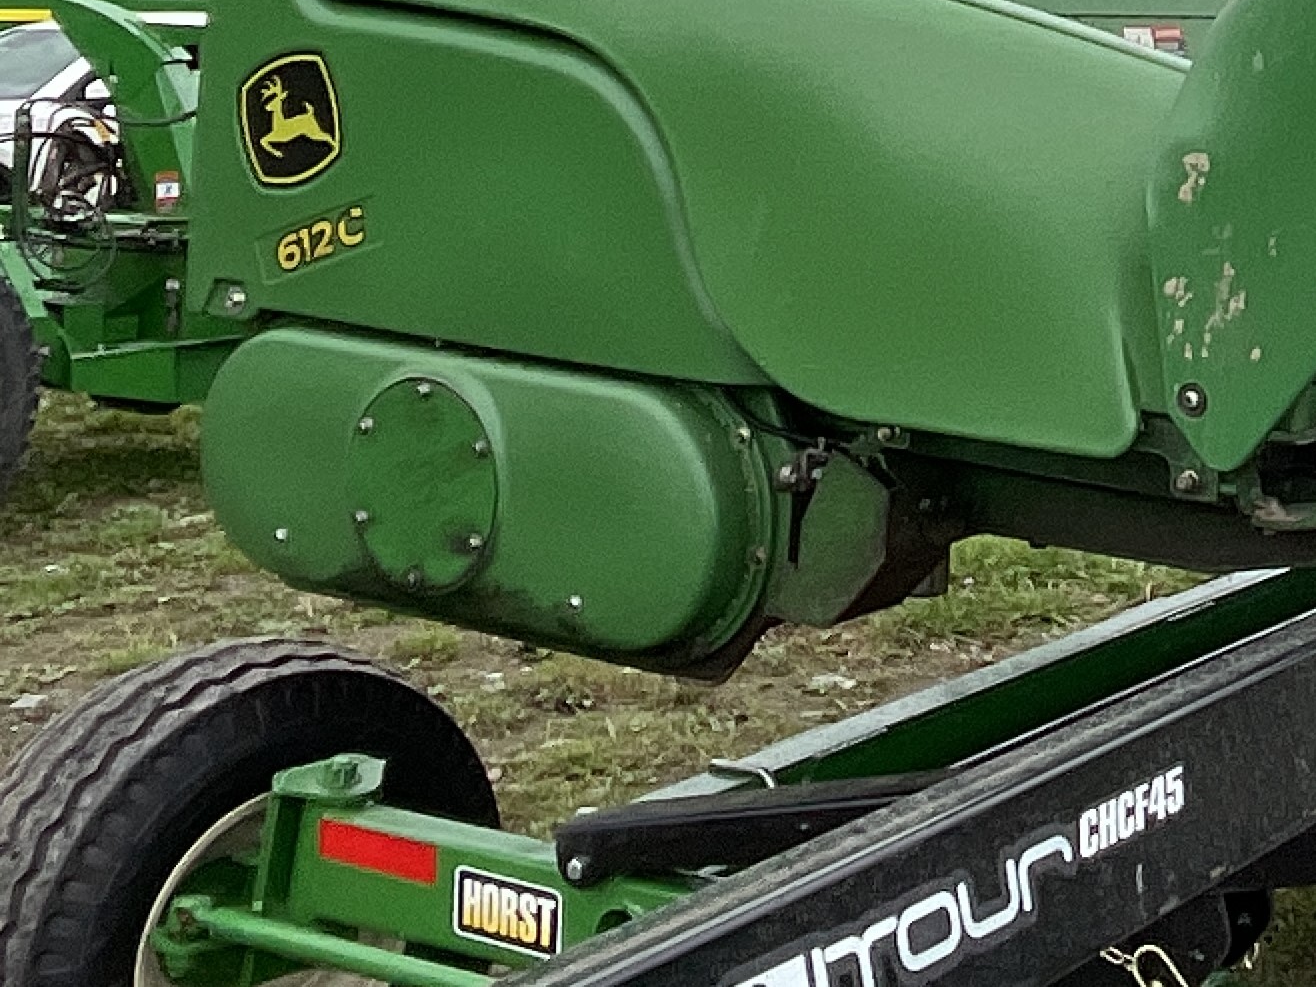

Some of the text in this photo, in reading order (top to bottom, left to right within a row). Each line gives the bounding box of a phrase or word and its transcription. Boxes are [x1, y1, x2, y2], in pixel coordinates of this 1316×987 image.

[277, 206, 364, 270] 612C
[1079, 765, 1185, 858] CHCF45
[463, 878, 557, 947] HORST
